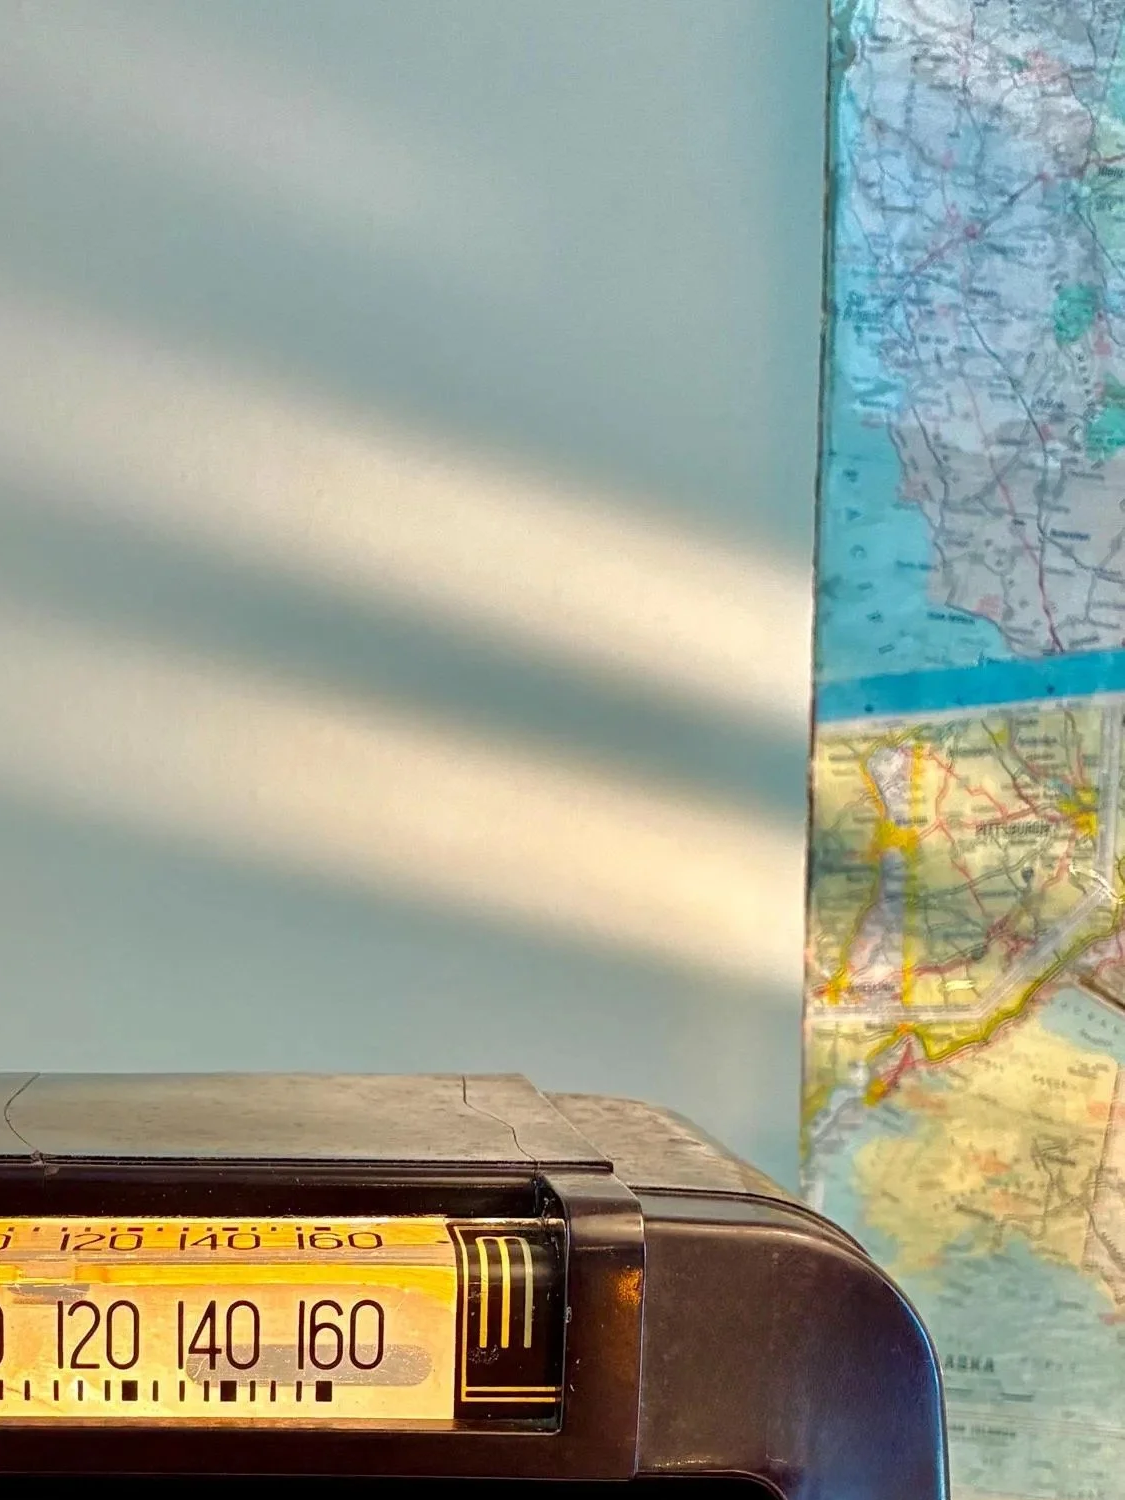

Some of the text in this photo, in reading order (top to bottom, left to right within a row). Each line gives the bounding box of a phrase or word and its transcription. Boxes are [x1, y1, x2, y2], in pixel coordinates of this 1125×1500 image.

[59, 1232, 143, 1252] 120
[179, 1231, 261, 1251] 140
[297, 1231, 383, 1250] 160
[57, 1300, 140, 1369] 120
[176, 1300, 261, 1369] 140
[297, 1300, 385, 1369] 160
